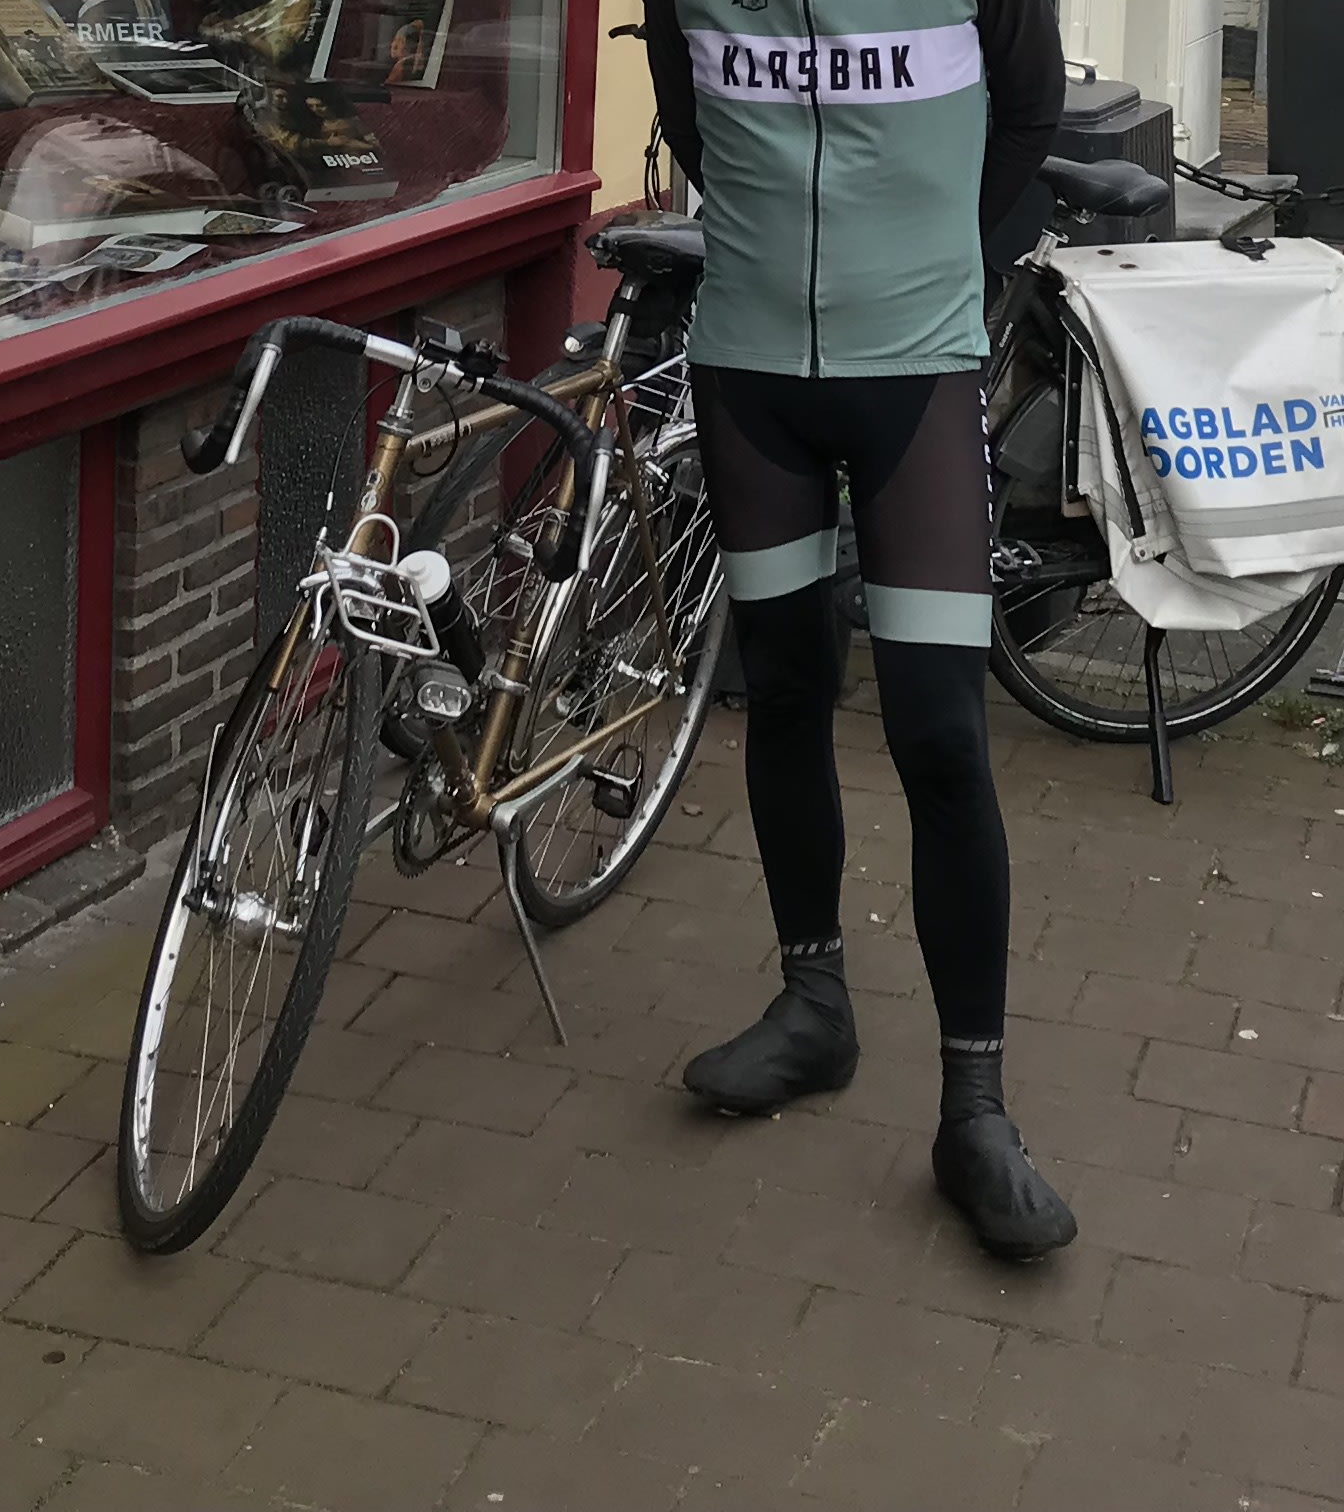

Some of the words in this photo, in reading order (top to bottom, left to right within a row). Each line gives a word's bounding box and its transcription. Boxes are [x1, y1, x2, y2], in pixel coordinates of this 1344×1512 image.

[65, 22, 165, 42] RMEER
[722, 44, 916, 93] KLASBAK
[322, 151, 379, 169] Bijbel
[1139, 398, 1317, 441] AGBLAD
[1146, 436, 1326, 480] OORDEN
